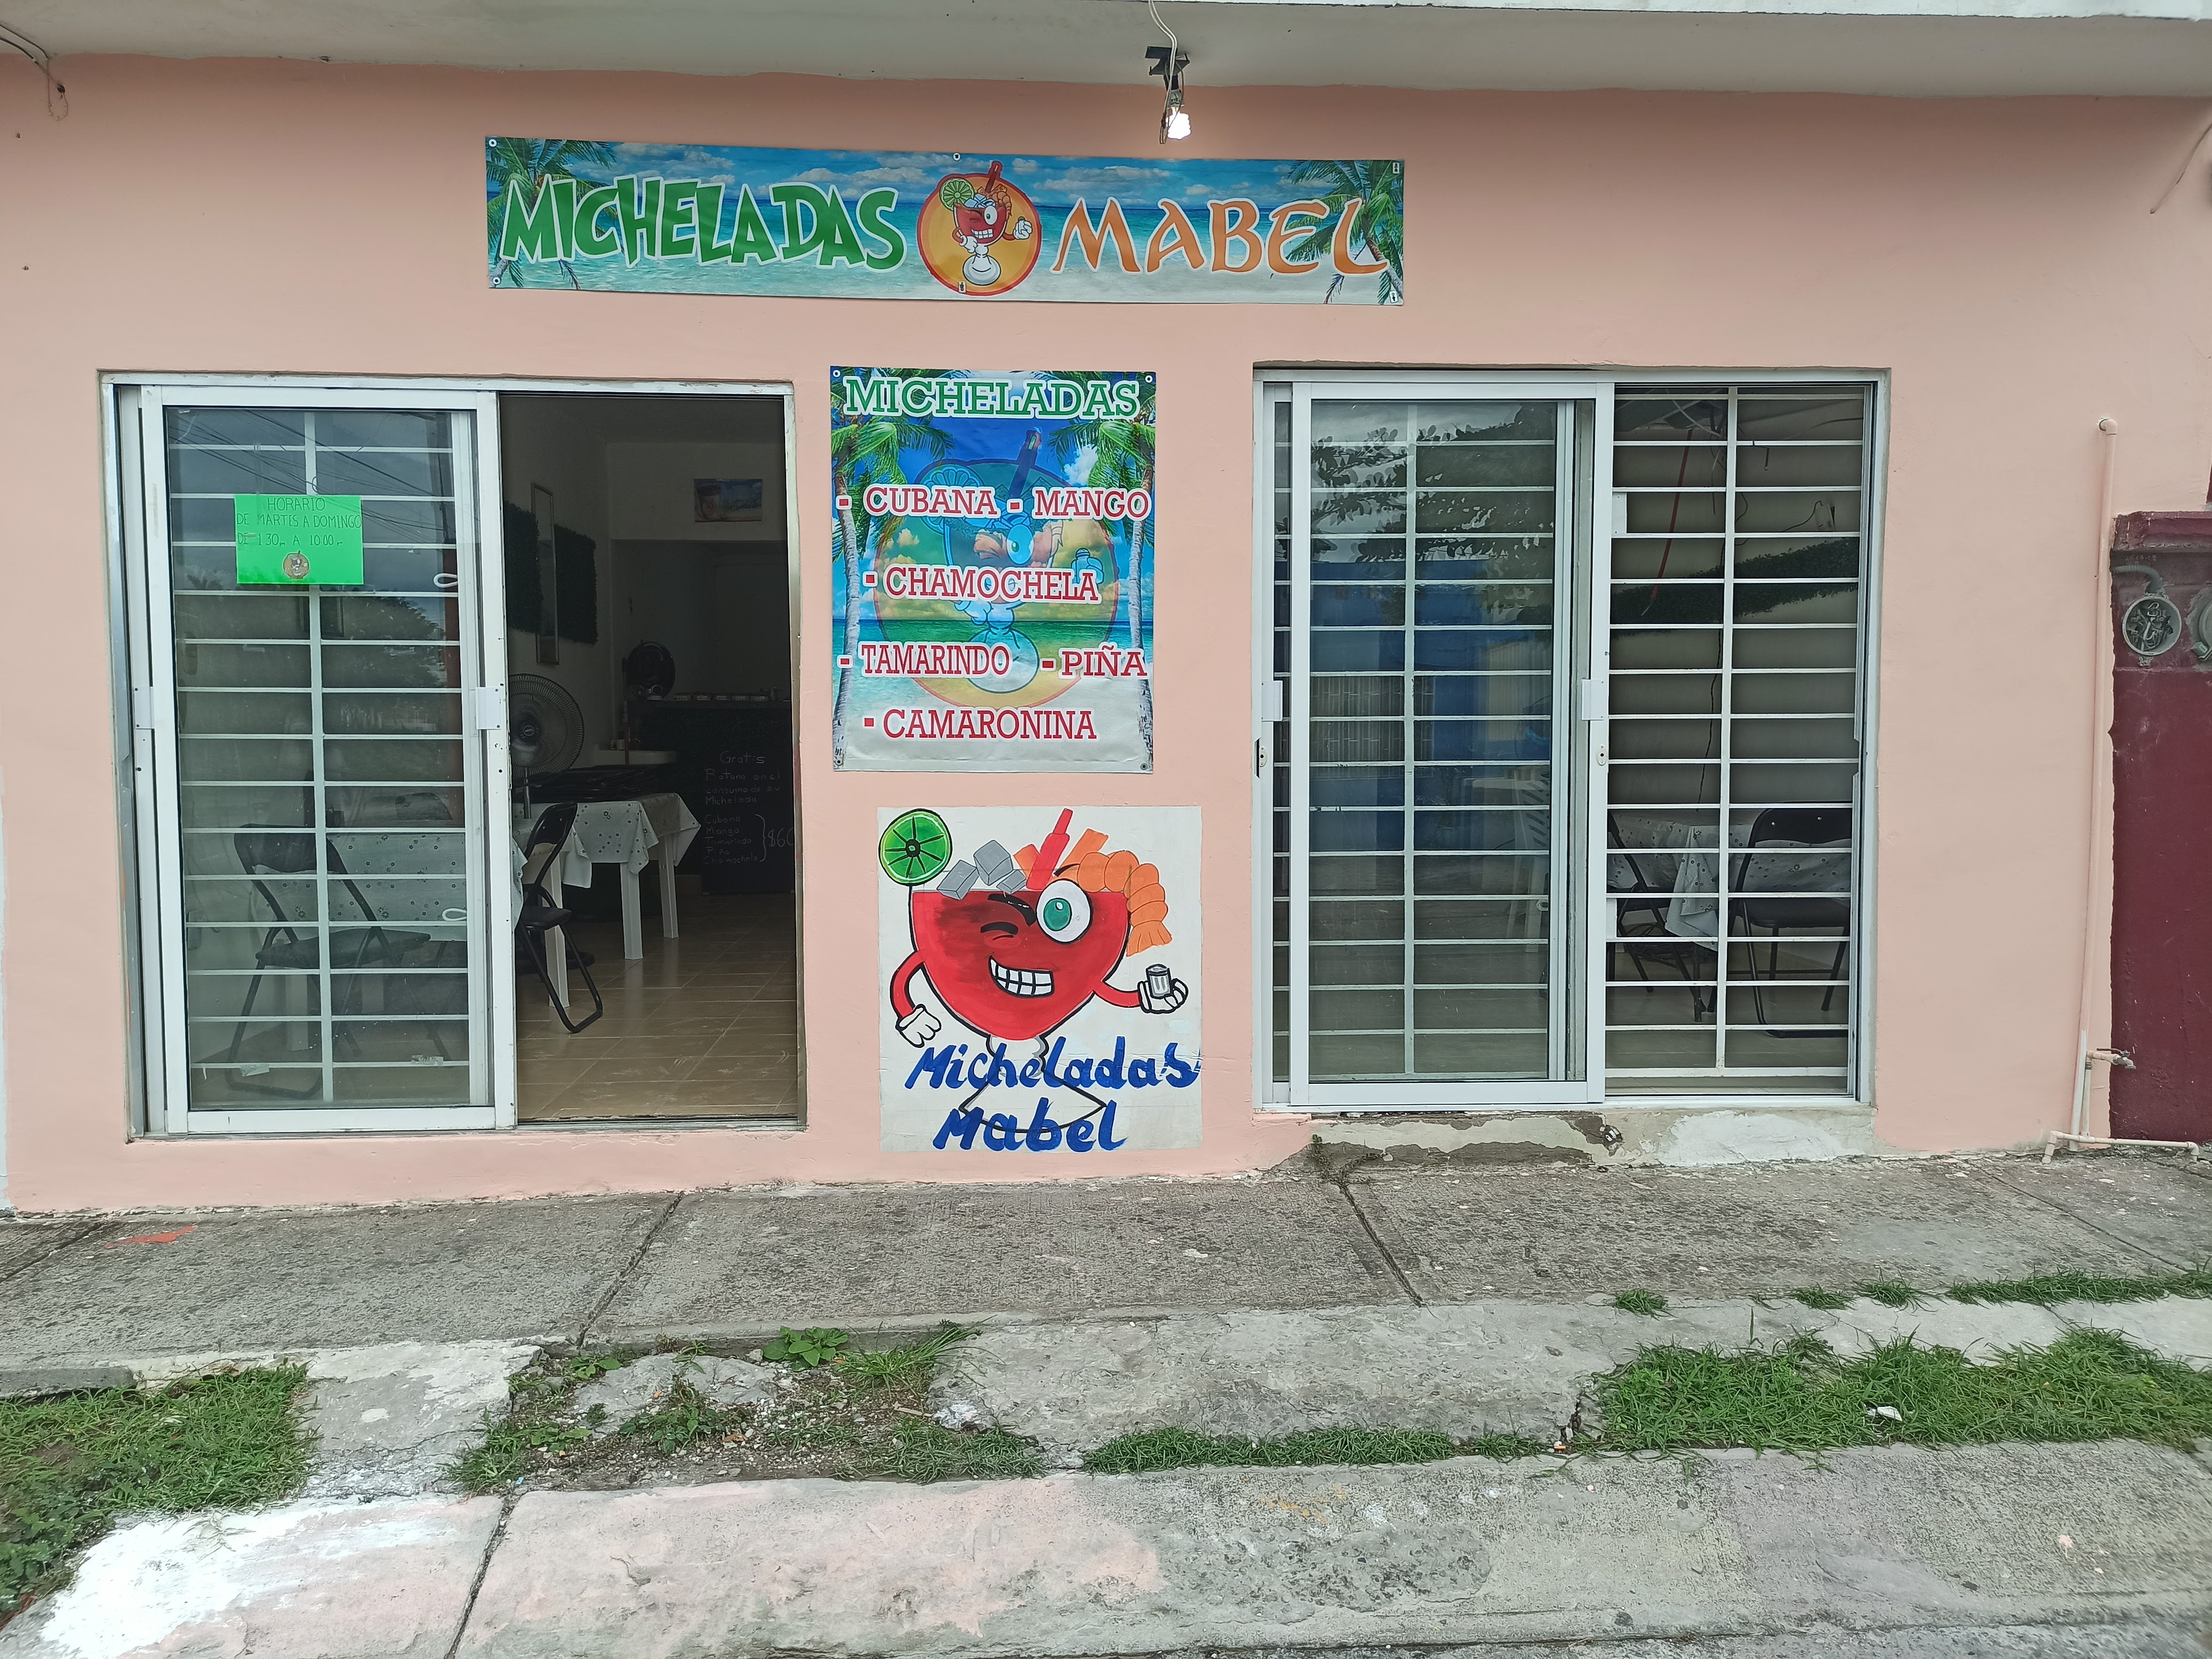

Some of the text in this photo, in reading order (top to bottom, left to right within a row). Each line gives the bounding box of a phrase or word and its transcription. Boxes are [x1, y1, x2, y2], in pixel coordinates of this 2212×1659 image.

[501, 176, 1389, 275] MICHELADAS MABEL
[844, 378, 1140, 418] MICHELADAS
[267, 497, 325, 511] HORARIO
[865, 486, 1149, 517] CUBANA MANGO
[237, 513, 362, 528] DE MARTES A DOMINGO
[237, 532, 248, 544] DE
[293, 535, 301, 545] A
[885, 567, 1098, 601] CHAMOCHELA
[861, 644, 1148, 677] TAMARINDO PIÑA
[882, 708, 1097, 739] CAMARONINA
[720, 750, 766, 763] Gratis
[706, 795, 757, 805] Michelada
[705, 814, 741, 824] Cubana
[706, 826, 739, 836] Mango
[704, 837, 752, 845] Tamarindo
[705, 846, 730, 855] Piña
[904, 1036, 1200, 1089] Micheladas
[932, 1097, 1127, 1152] Mabel
